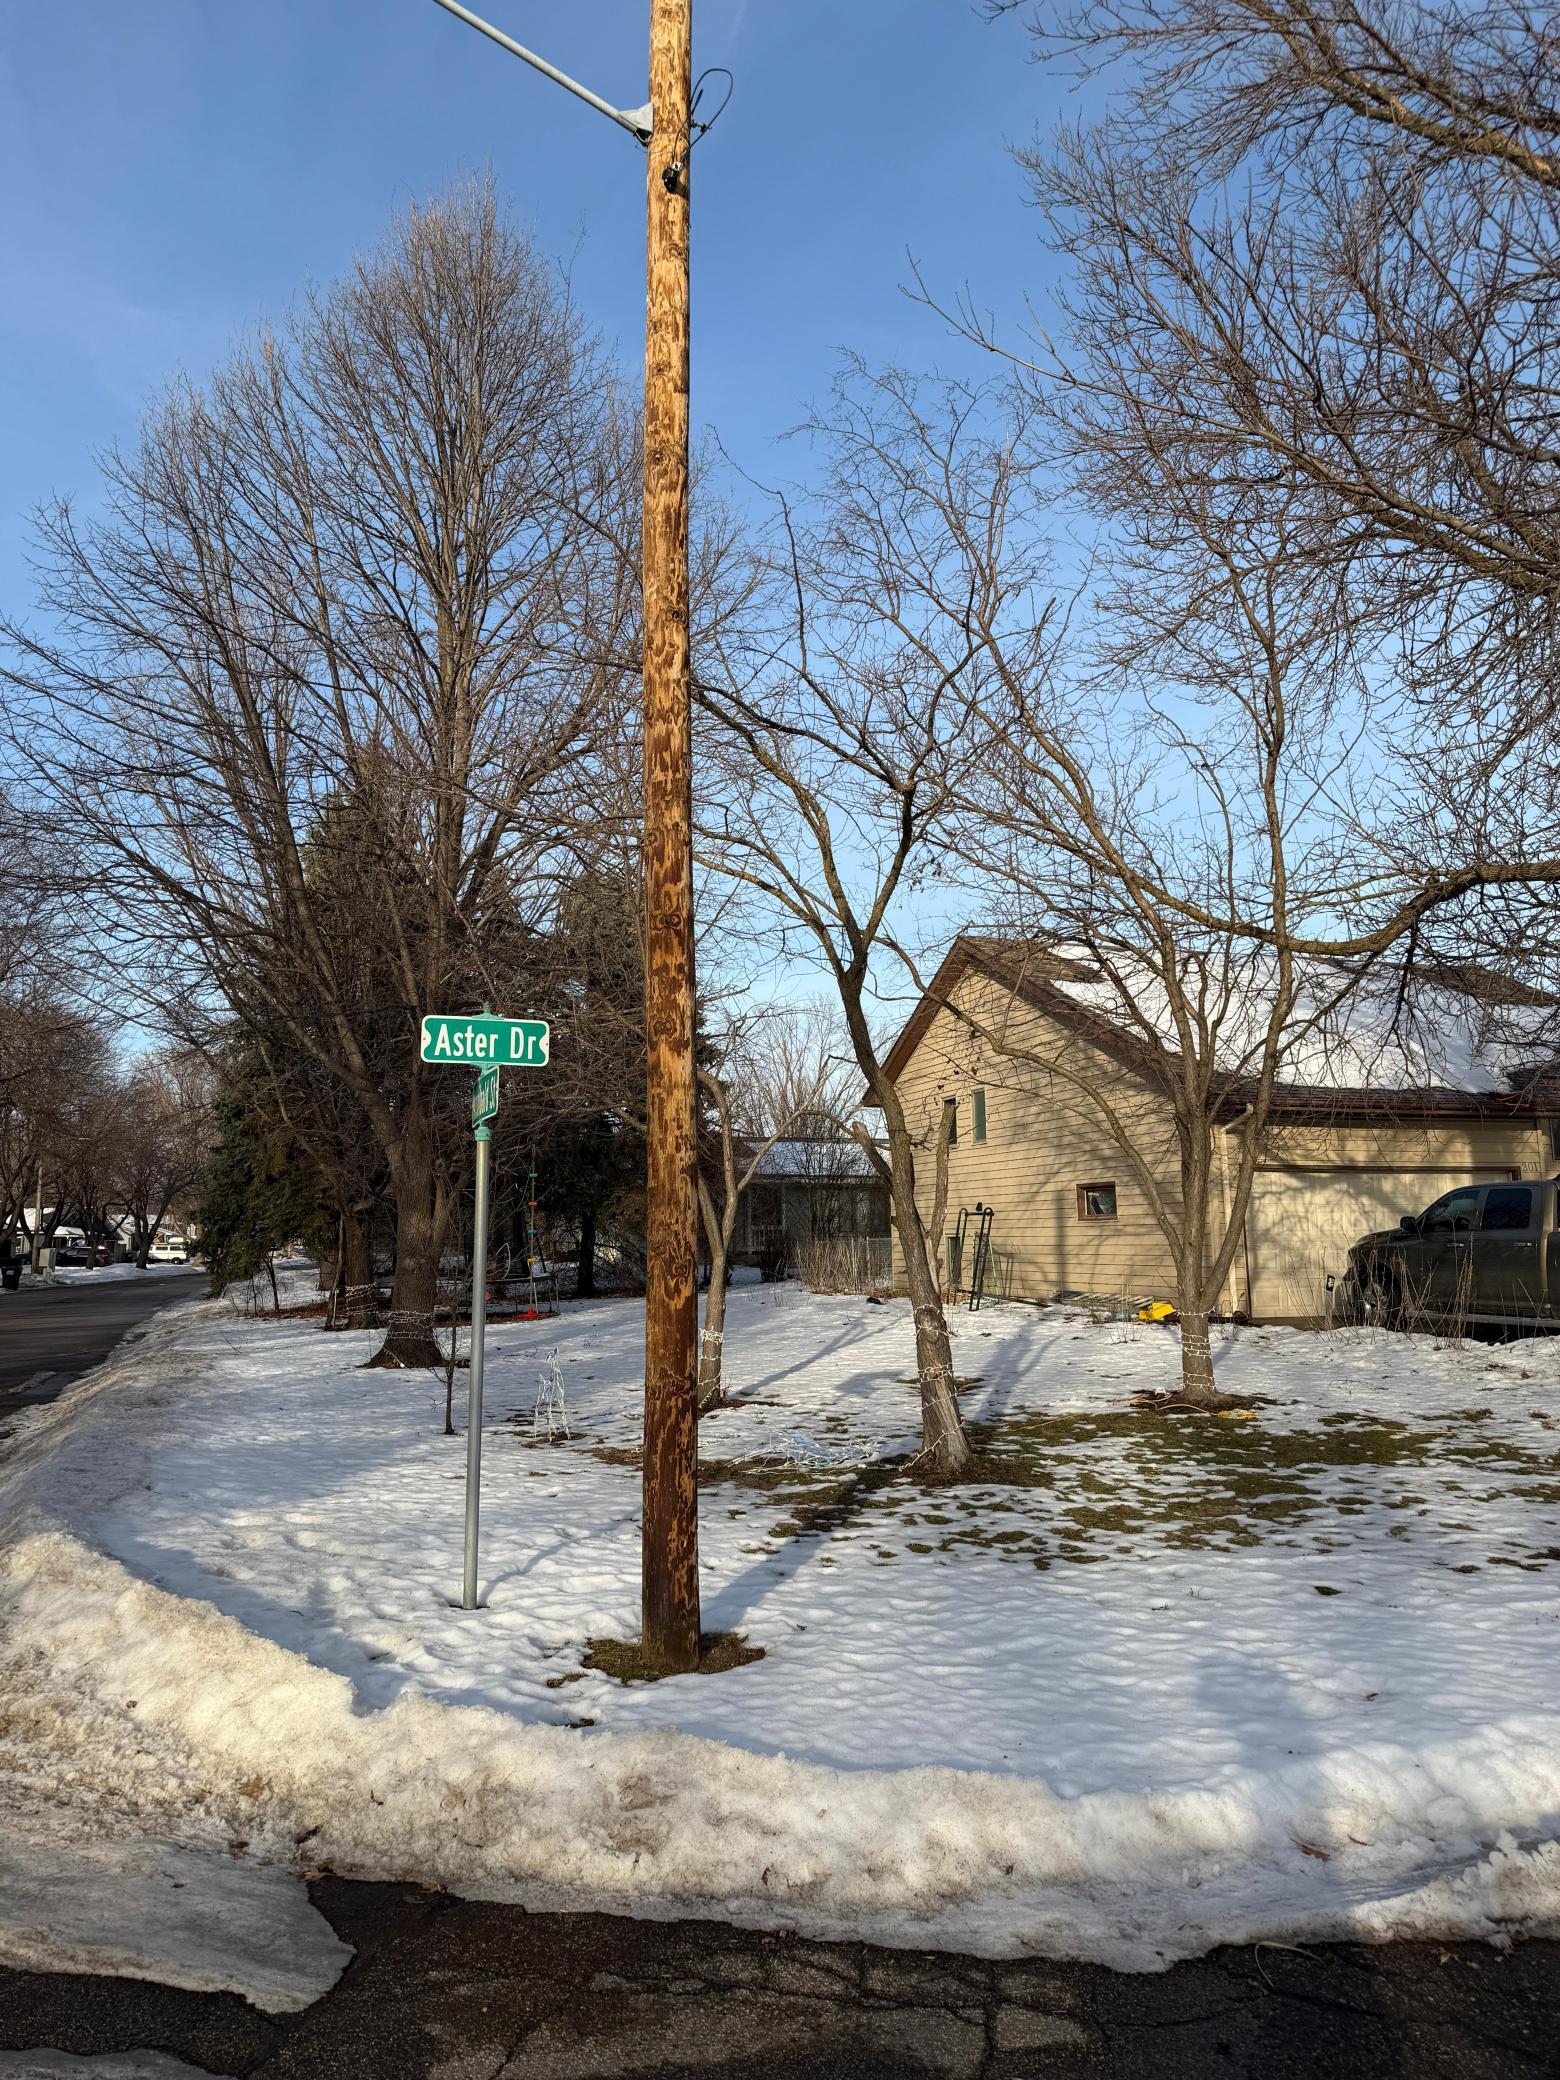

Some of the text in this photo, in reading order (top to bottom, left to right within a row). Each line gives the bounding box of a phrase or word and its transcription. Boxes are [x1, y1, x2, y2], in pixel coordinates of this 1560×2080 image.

[434, 1023, 536, 1059] Aster Dr
[1521, 1162, 1538, 1172] 301
